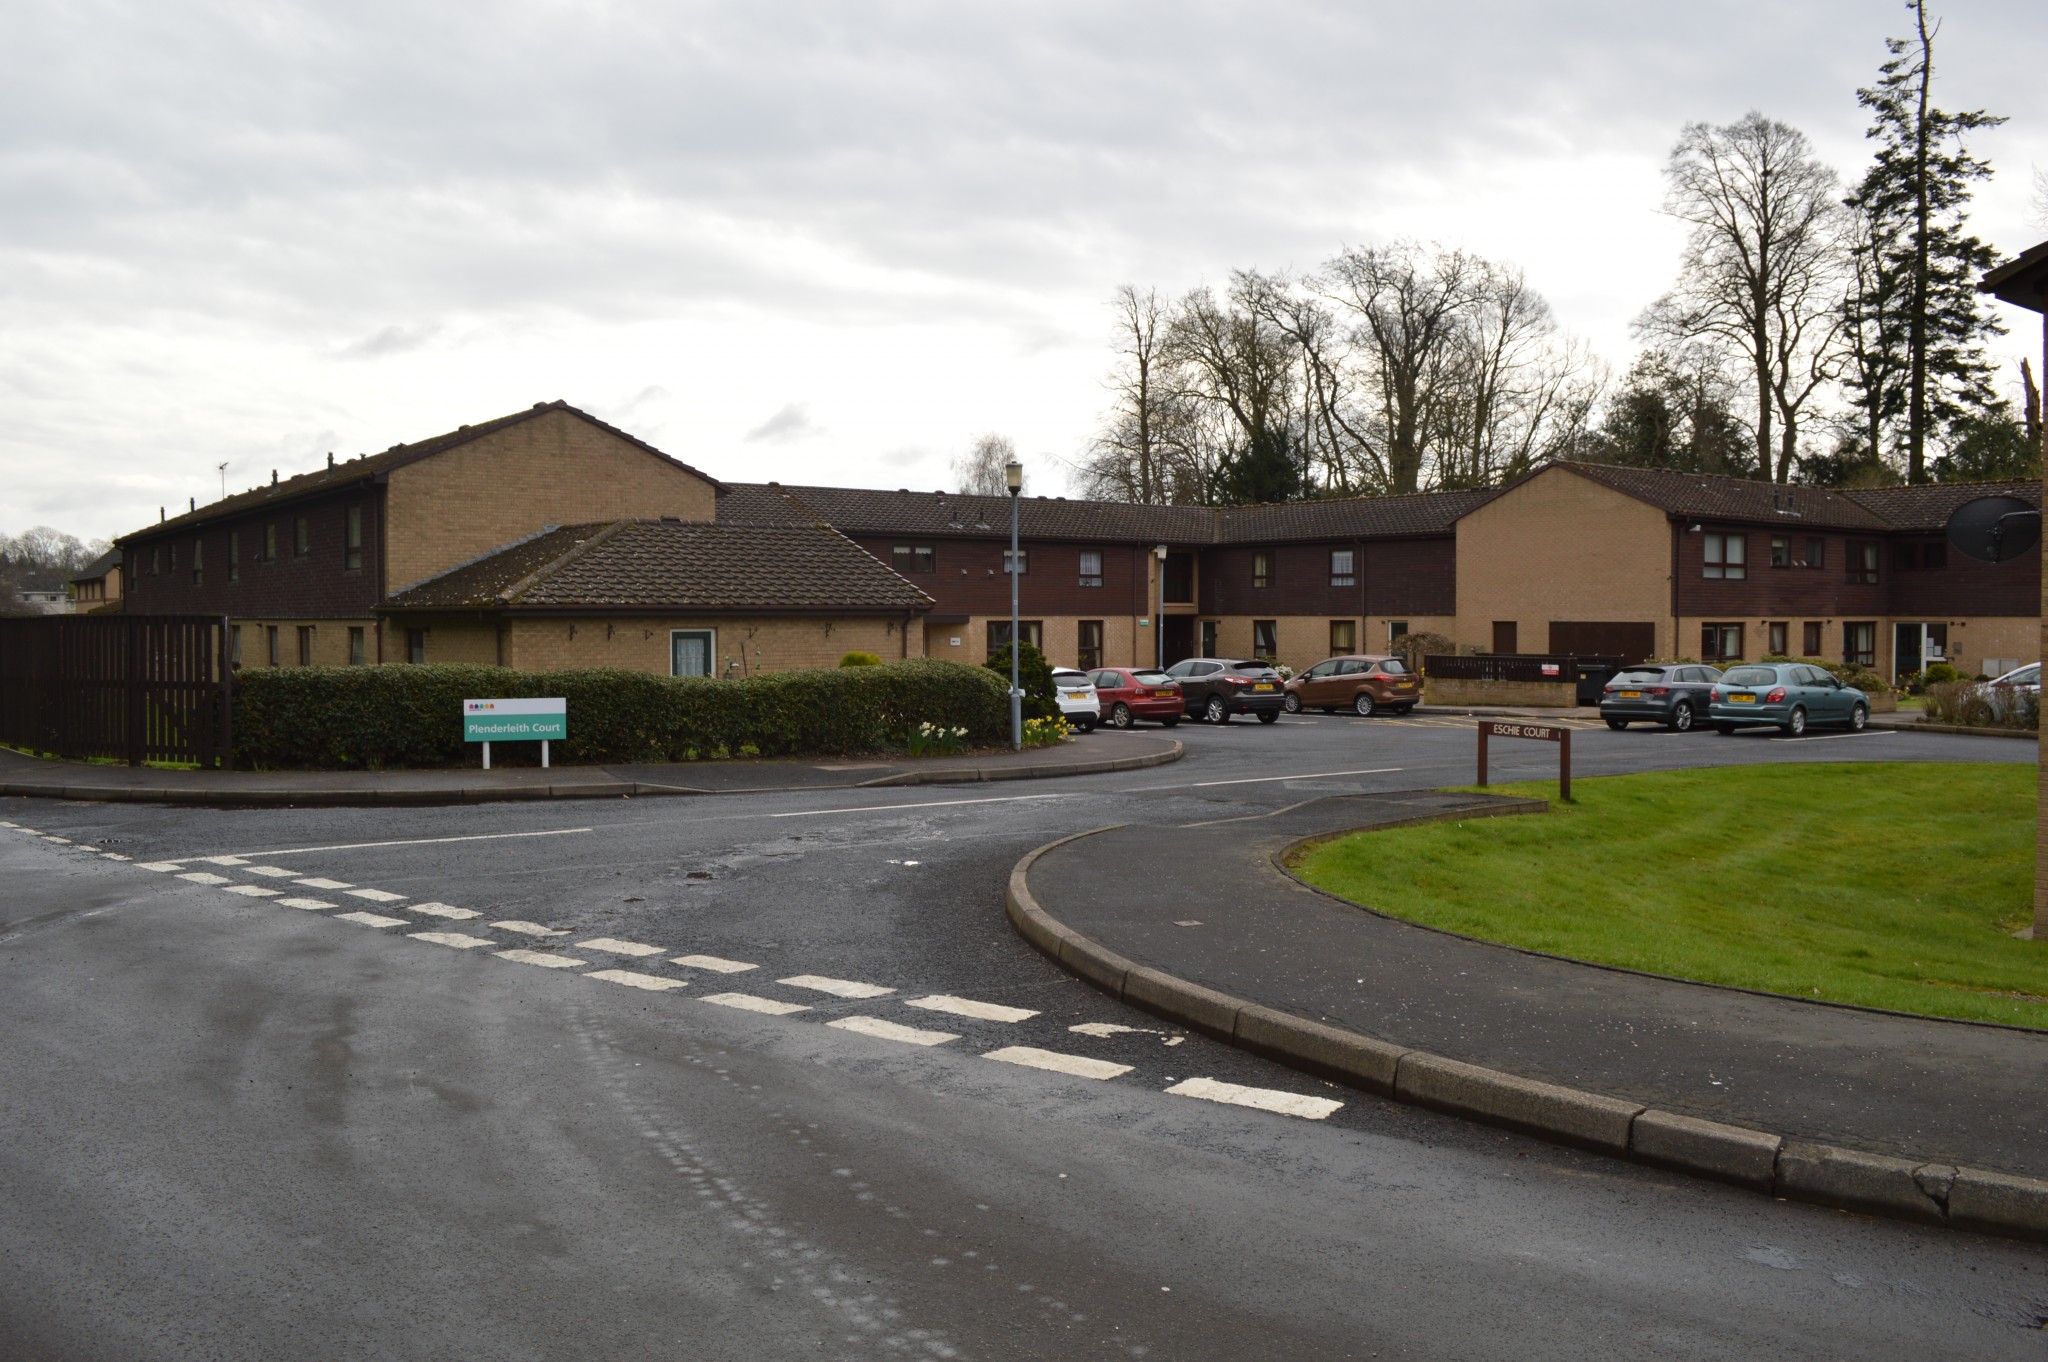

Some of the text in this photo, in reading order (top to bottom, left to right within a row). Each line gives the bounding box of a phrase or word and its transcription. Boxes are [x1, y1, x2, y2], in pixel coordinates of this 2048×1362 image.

[469, 723, 560, 733] Plenderleith Court
[1493, 724, 1550, 738] ESCHIE COURT
